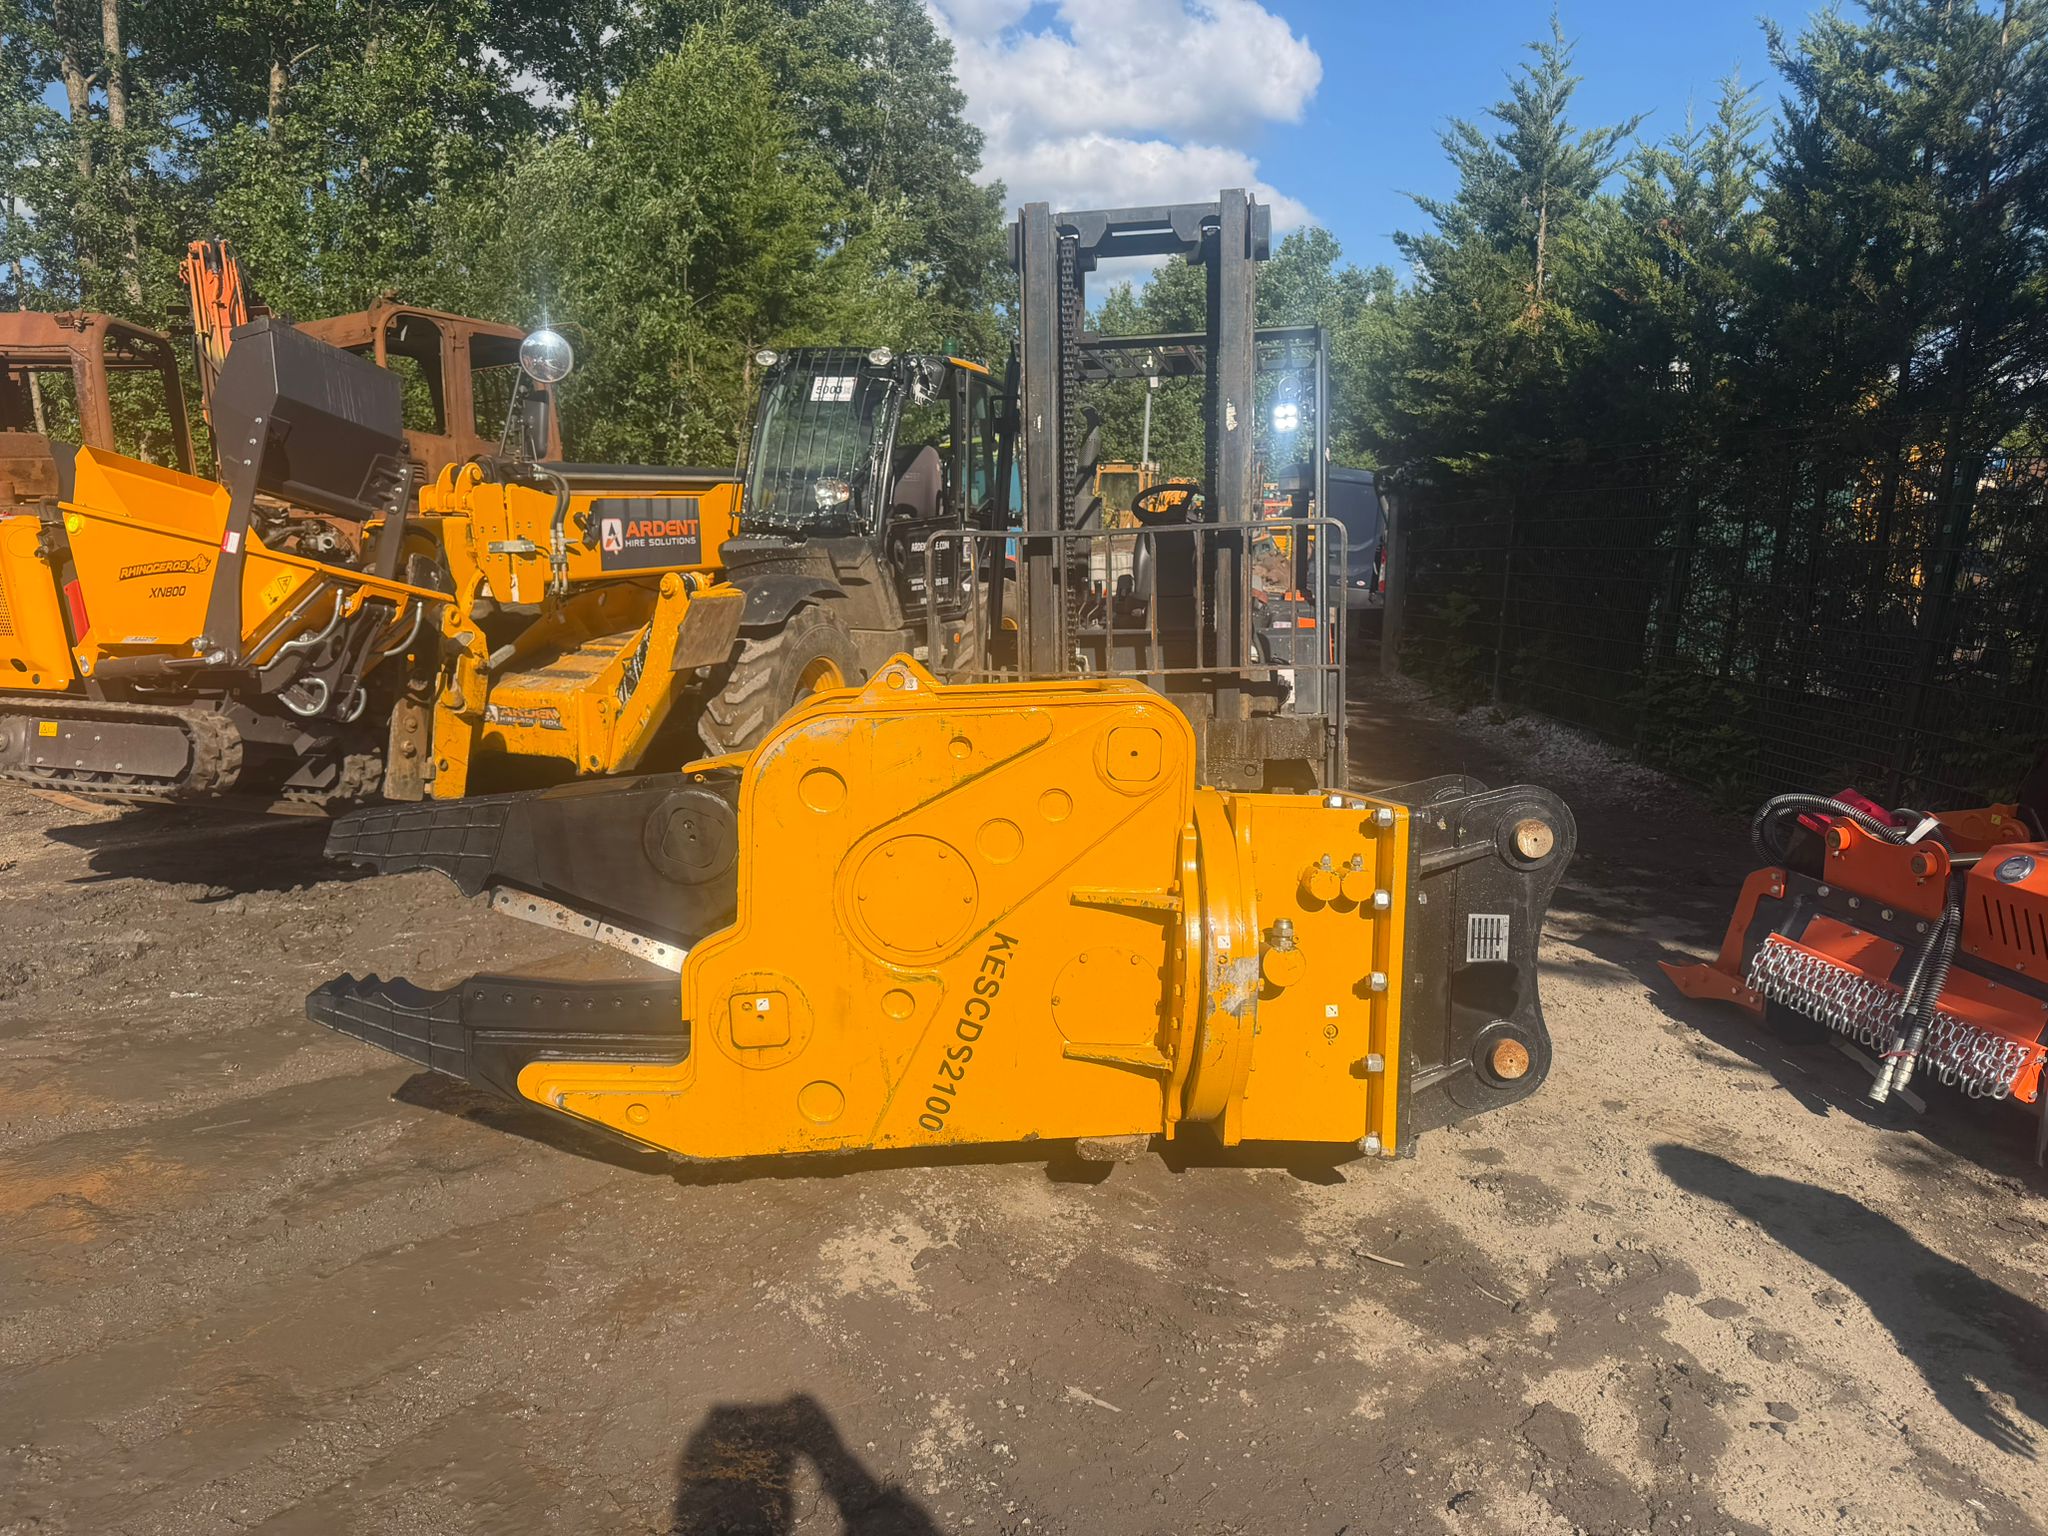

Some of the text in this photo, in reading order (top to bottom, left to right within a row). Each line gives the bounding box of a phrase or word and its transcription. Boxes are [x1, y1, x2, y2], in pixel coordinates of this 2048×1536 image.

[625, 520, 698, 537] ARDENT
[625, 536, 697, 548] HIRE SOLUTIONS
[119, 560, 188, 581] RHINOCEROS
[149, 586, 186, 598] XN800
[500, 708, 561, 720] ARDEN
[918, 931, 1019, 1132] KESCDS2100
